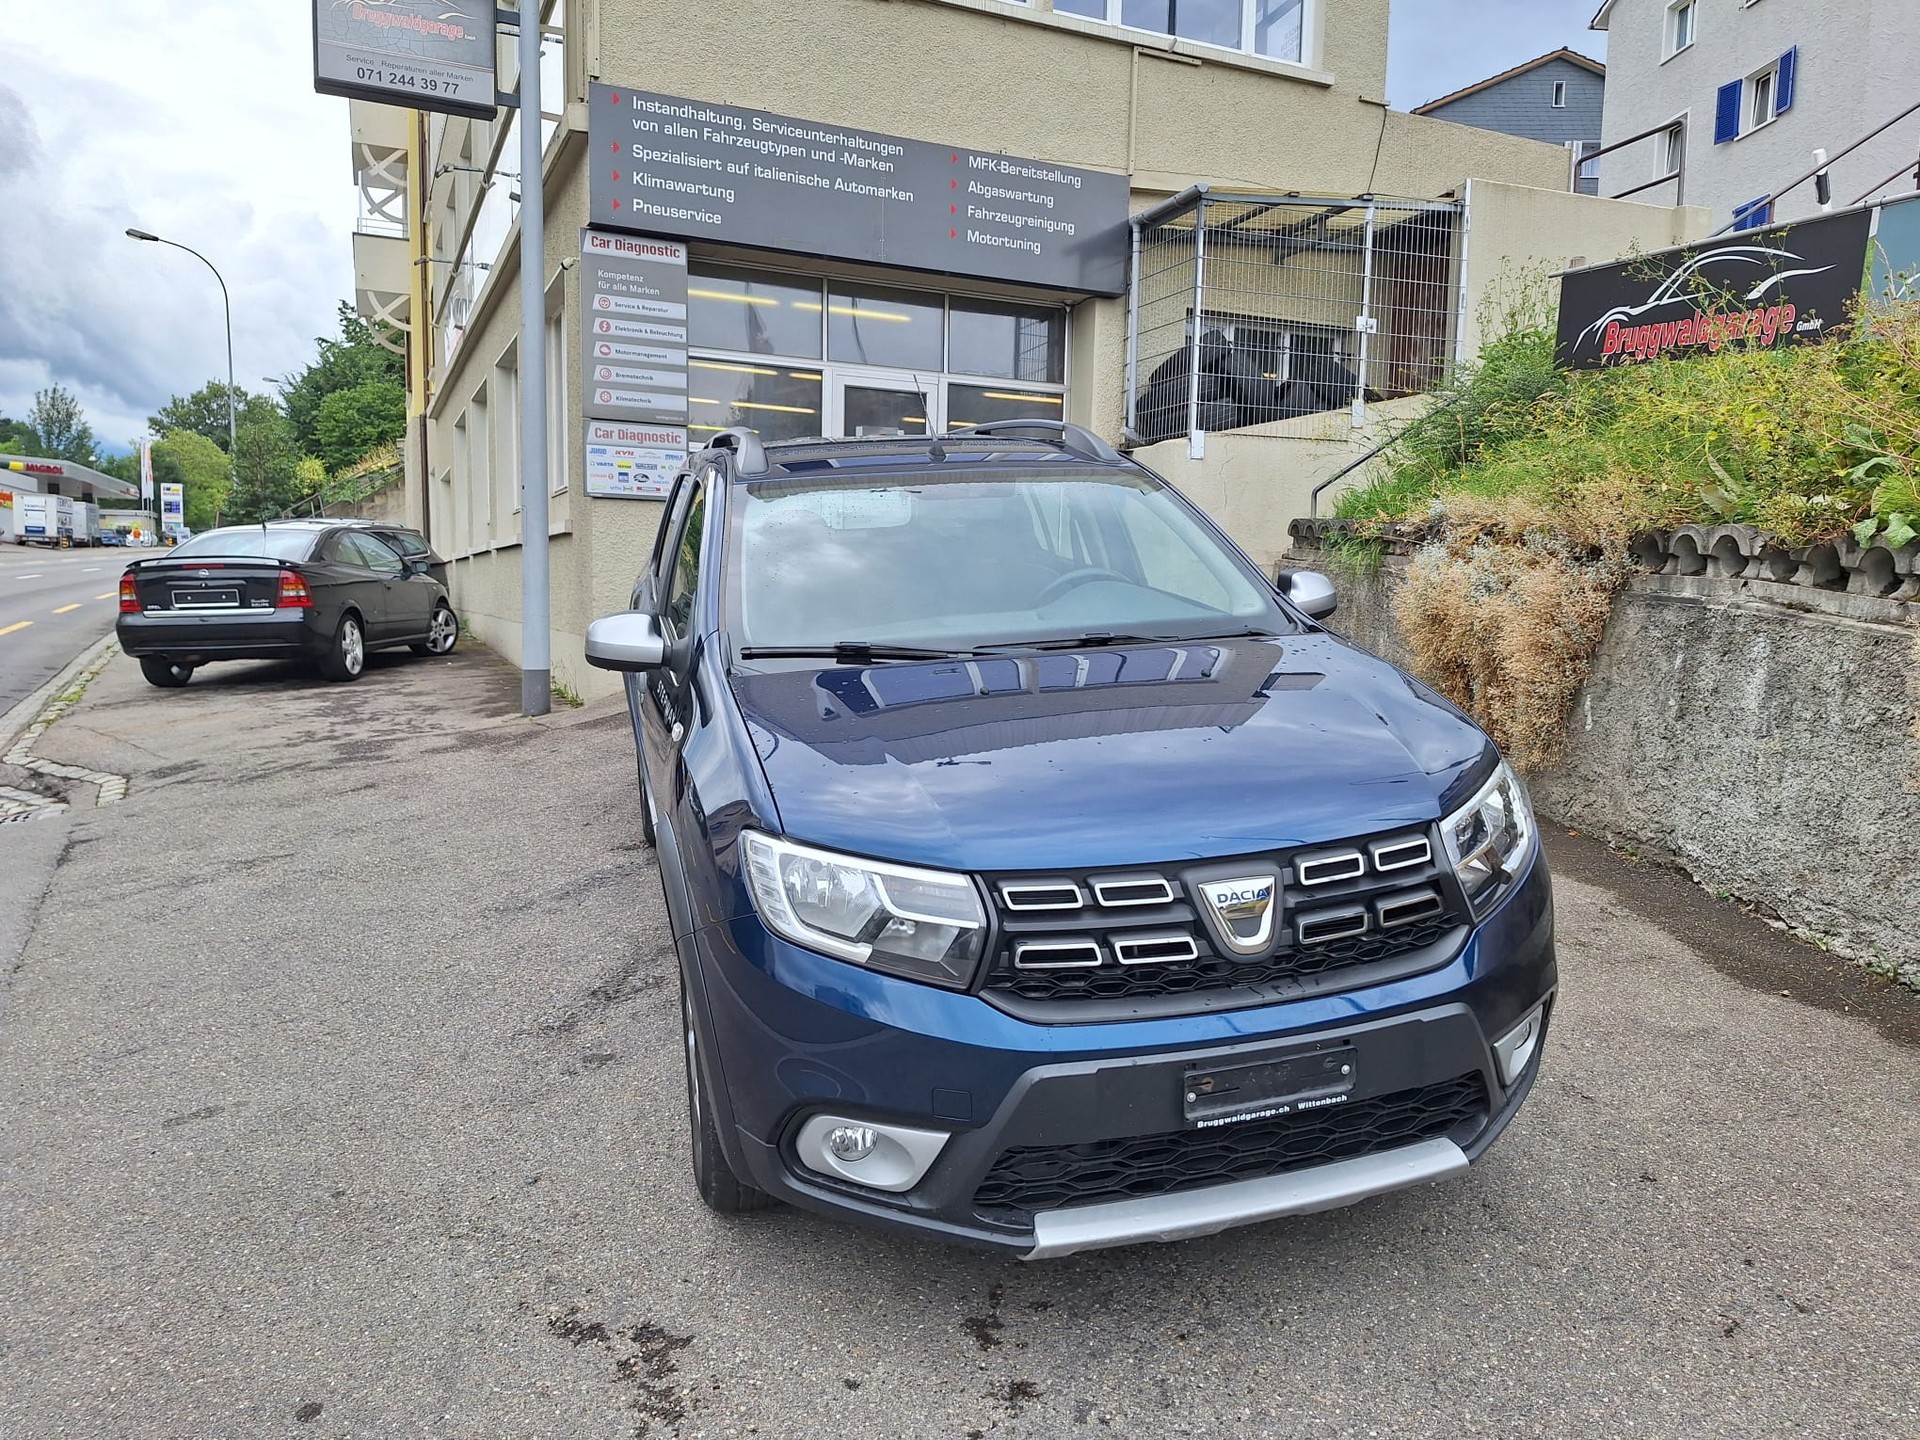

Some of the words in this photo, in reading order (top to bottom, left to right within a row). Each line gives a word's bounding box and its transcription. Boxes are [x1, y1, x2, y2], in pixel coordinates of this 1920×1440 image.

[352, 3, 465, 41] Bruggwaldgarage
[346, 54, 375, 66] Service
[429, 68, 445, 77] aller
[446, 71, 474, 82] Marken
[356, 67, 382, 82] 071
[389, 73, 415, 88] 244
[420, 79, 438, 92] 39
[442, 81, 459, 95] 77
[632, 96, 746, 130] Instandhaltung,
[752, 117, 904, 156] Serviceunterhaltungen
[632, 119, 658, 133] von
[664, 123, 698, 139] allen
[703, 127, 806, 158] Fahrzeugtypen
[811, 148, 835, 163] und
[839, 152, 894, 173] -Marken
[632, 144, 722, 171] Spezialisiert
[727, 160, 751, 175] auf
[754, 163, 830, 189] italienische
[834, 177, 914, 202] Automarken
[968, 155, 1081, 189] MFK-Bereitstellung
[632, 171, 735, 203] Klimawartung
[967, 180, 1054, 208] Abgaswartung
[632, 198, 722, 225] Pneuservice
[967, 205, 1075, 235] Fahrzeugreinigung
[591, 235, 611, 249] Car
[615, 238, 680, 259] Diagnostic
[967, 229, 1041, 255] Motortuning
[597, 269, 644, 283] Kompetenz
[597, 280, 610, 289] für
[612, 283, 627, 292] alle
[629, 284, 660, 296] Marken
[614, 301, 635, 310] Service
[641, 305, 669, 313] Reparatur
[615, 325, 643, 334] Elektronik
[649, 329, 683, 339] Beleuchtung
[1603, 303, 1795, 358] Bruggwaldgarage
[1796, 318, 1822, 332] GmbH
[615, 349, 668, 359] Motormanagement
[615, 372, 654, 381] Bremstechnik
[615, 395, 652, 404] Klimatechnik
[594, 427, 615, 439] Car
[617, 428, 681, 444] Diagnostic
[1217, 888, 1269, 903] DACIA
[1197, 1106, 1290, 1128] Bruggwaldgarage.ch
